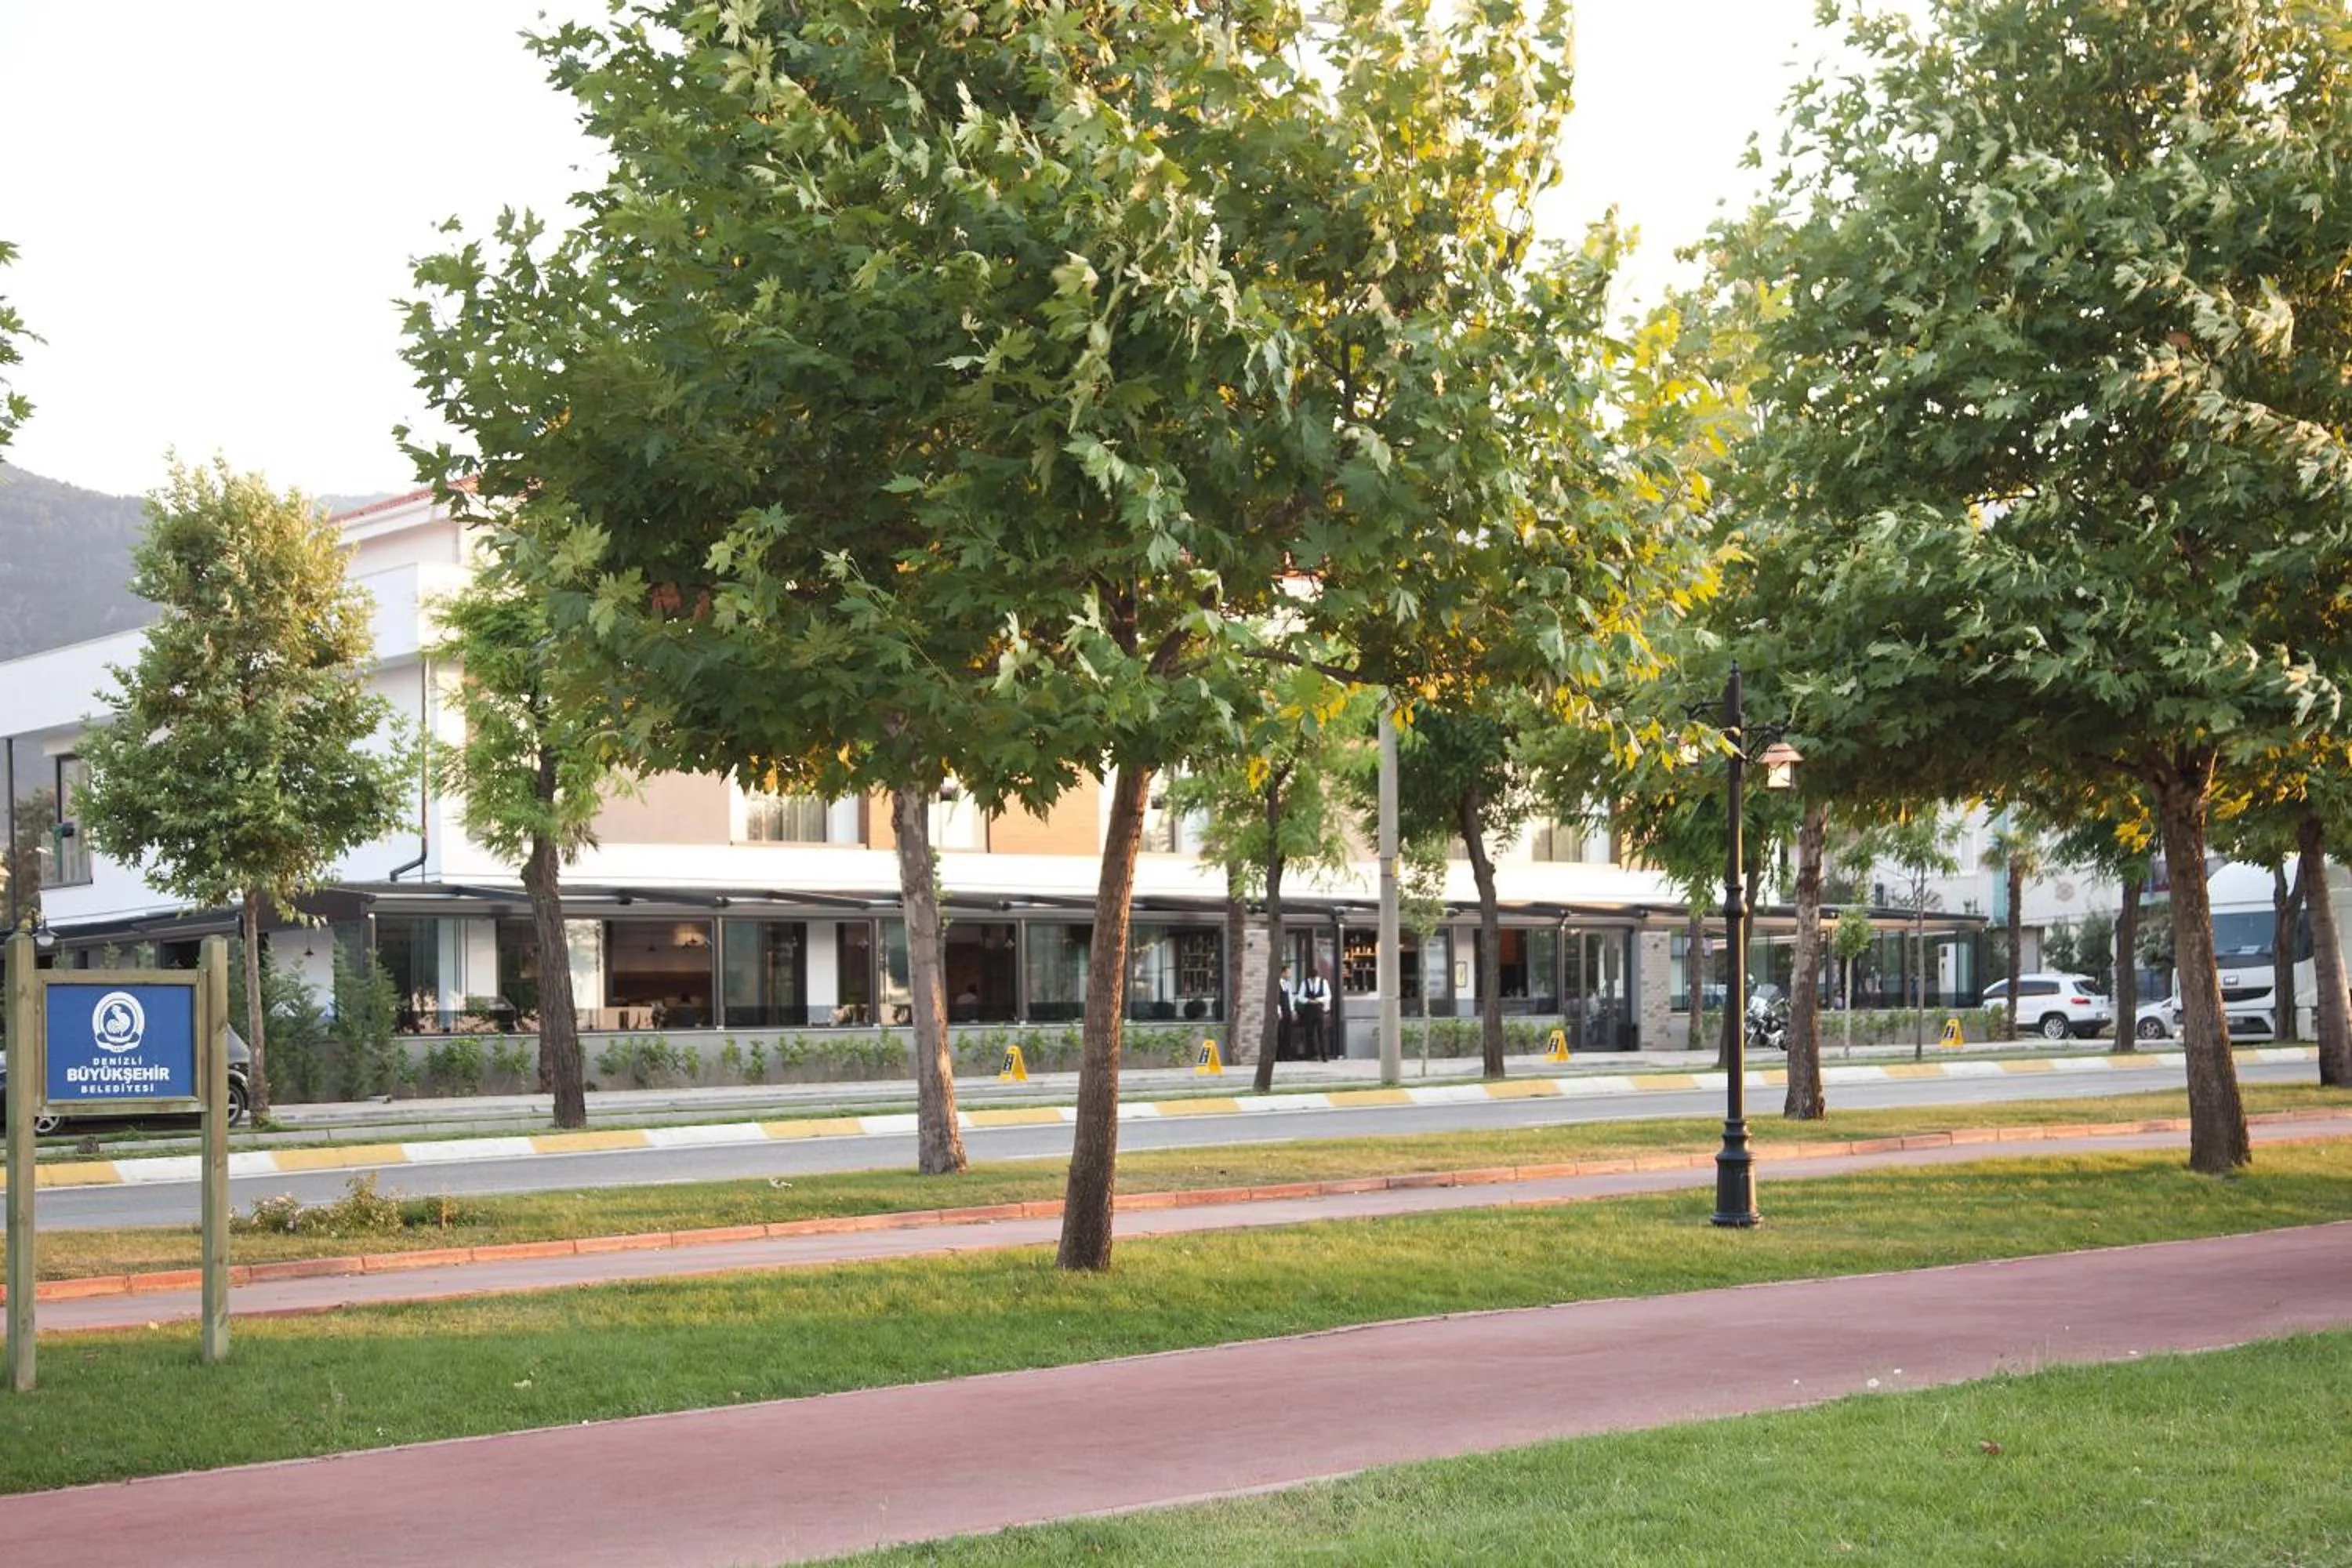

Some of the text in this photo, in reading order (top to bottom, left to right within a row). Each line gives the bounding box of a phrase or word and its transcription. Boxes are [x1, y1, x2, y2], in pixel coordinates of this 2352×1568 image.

[93, 1056, 142, 1065] DENİZLİ
[67, 1065, 170, 1083] BÜYÜKŞEHİR
[81, 1083, 154, 1094] BELEDİYESİ
